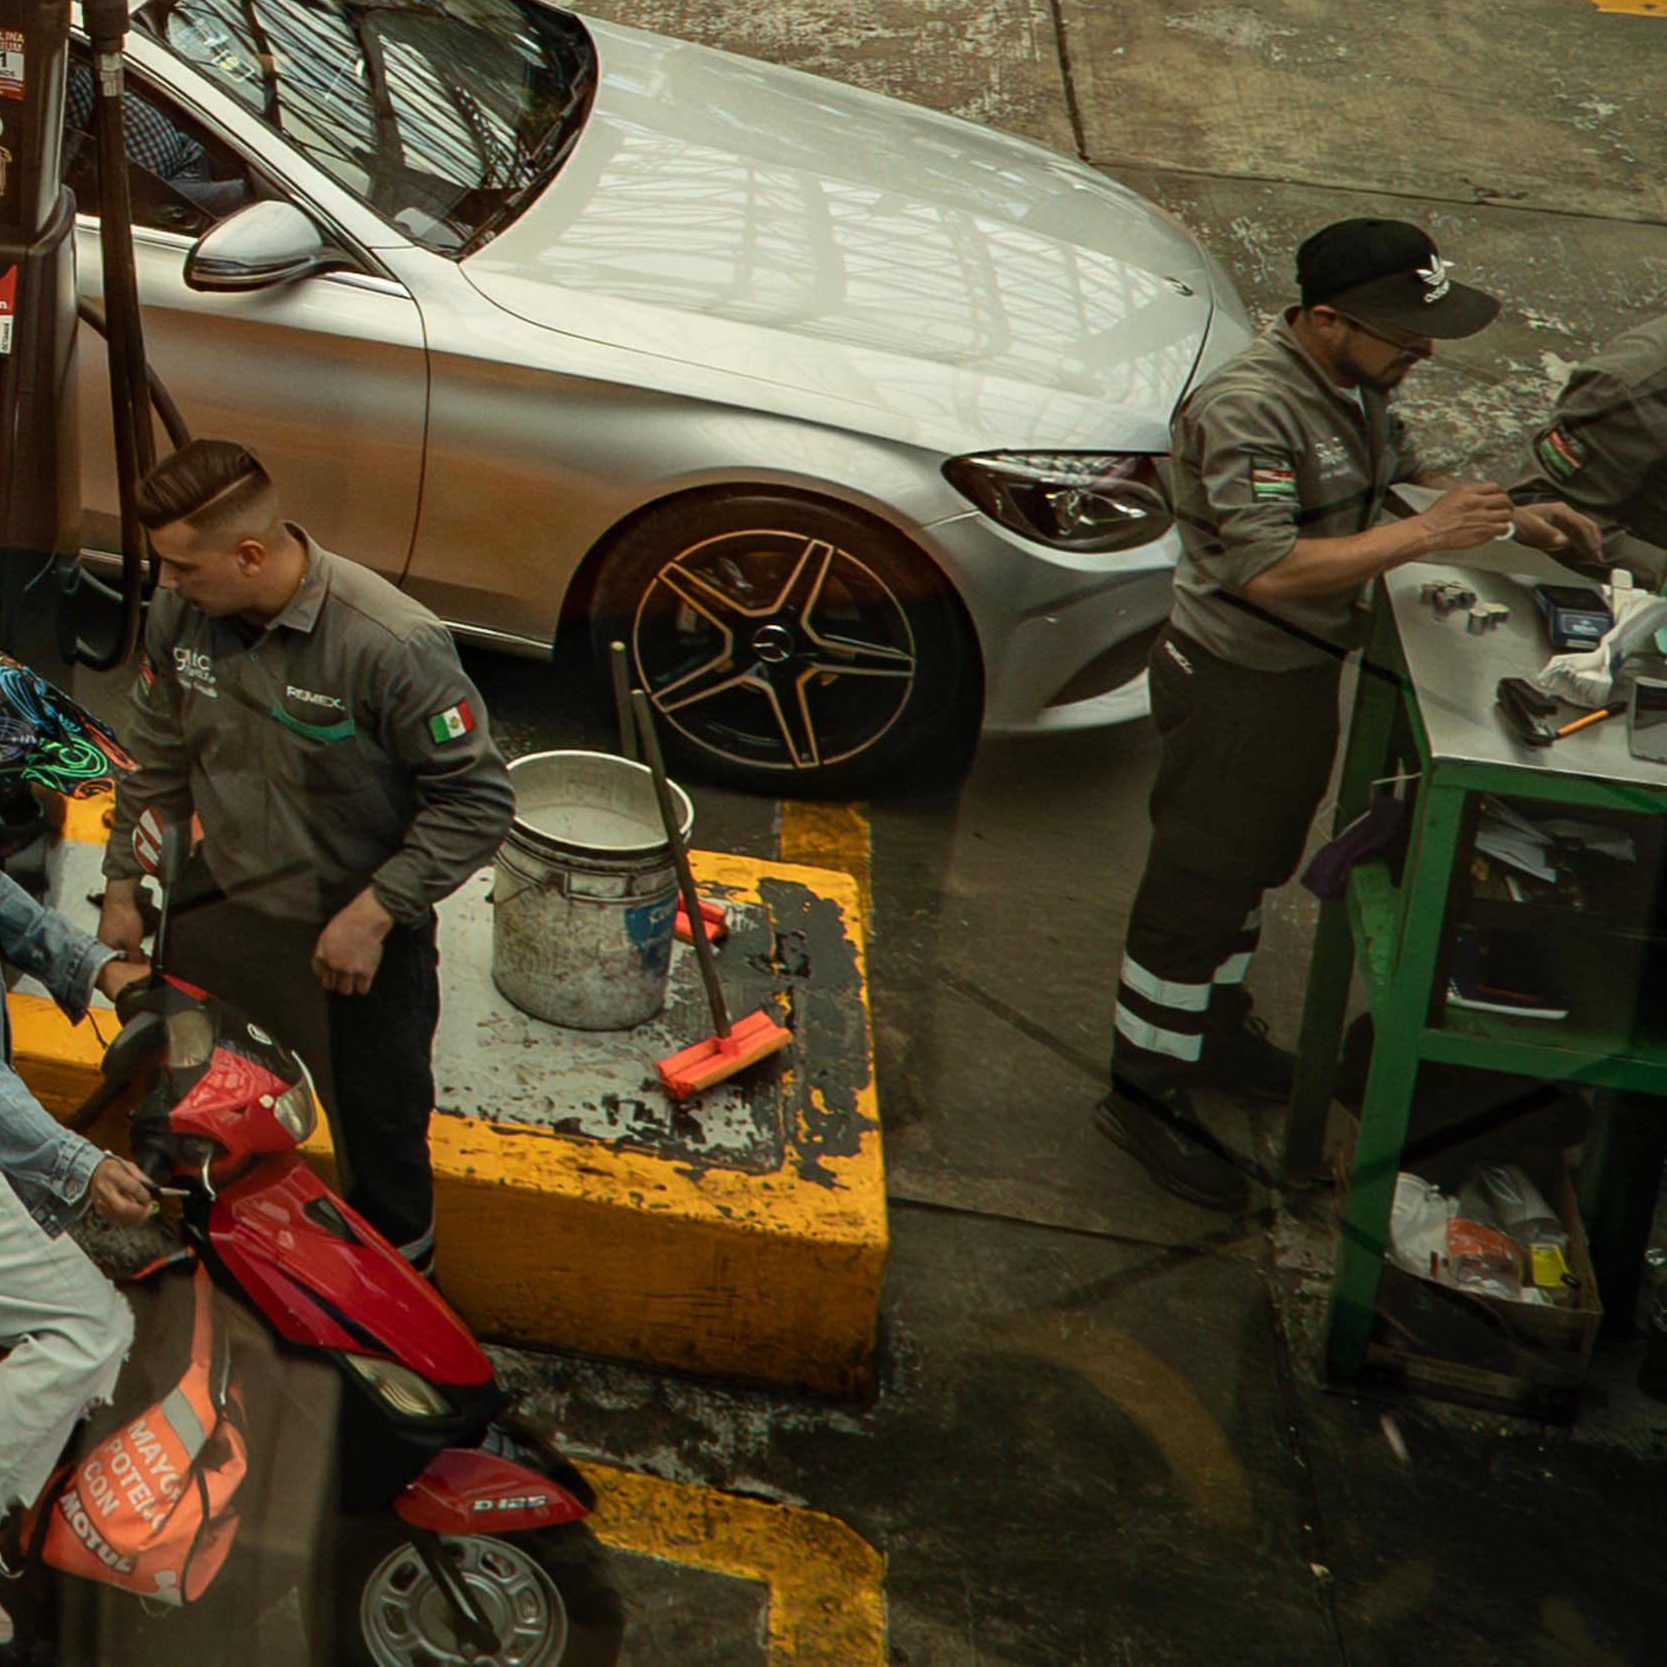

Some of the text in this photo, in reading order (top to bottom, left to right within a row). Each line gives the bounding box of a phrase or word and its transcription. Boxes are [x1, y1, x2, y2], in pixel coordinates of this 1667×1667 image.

[83, 1461, 120, 1517] CON
[127, 1419, 183, 1503] MAYO
[60, 1490, 133, 1574] MOTUL
